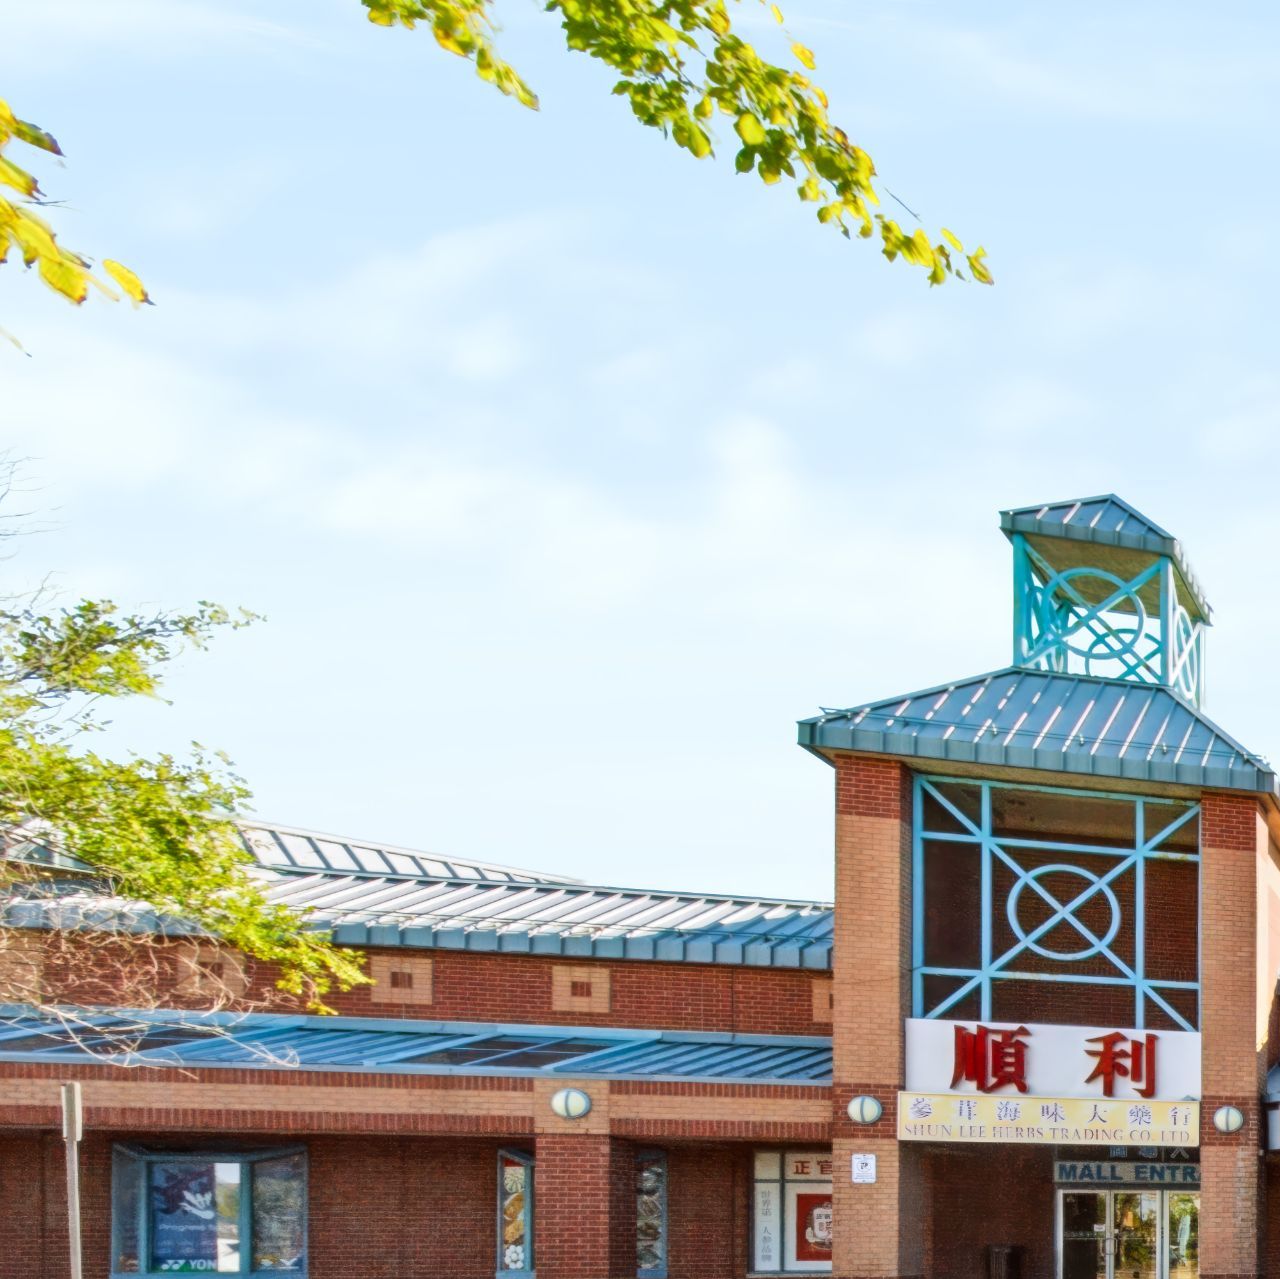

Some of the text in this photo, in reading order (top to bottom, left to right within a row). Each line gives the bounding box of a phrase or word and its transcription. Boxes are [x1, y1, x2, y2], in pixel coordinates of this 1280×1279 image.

[950, 1024, 1160, 1099] 順利
[905, 1124, 952, 1137] SHUN
[960, 1124, 986, 1138] LEE
[992, 1126, 1044, 1139] HERBS
[1049, 1127, 1123, 1141] TRADING
[1058, 1163, 1200, 1182] MALL ENTR
